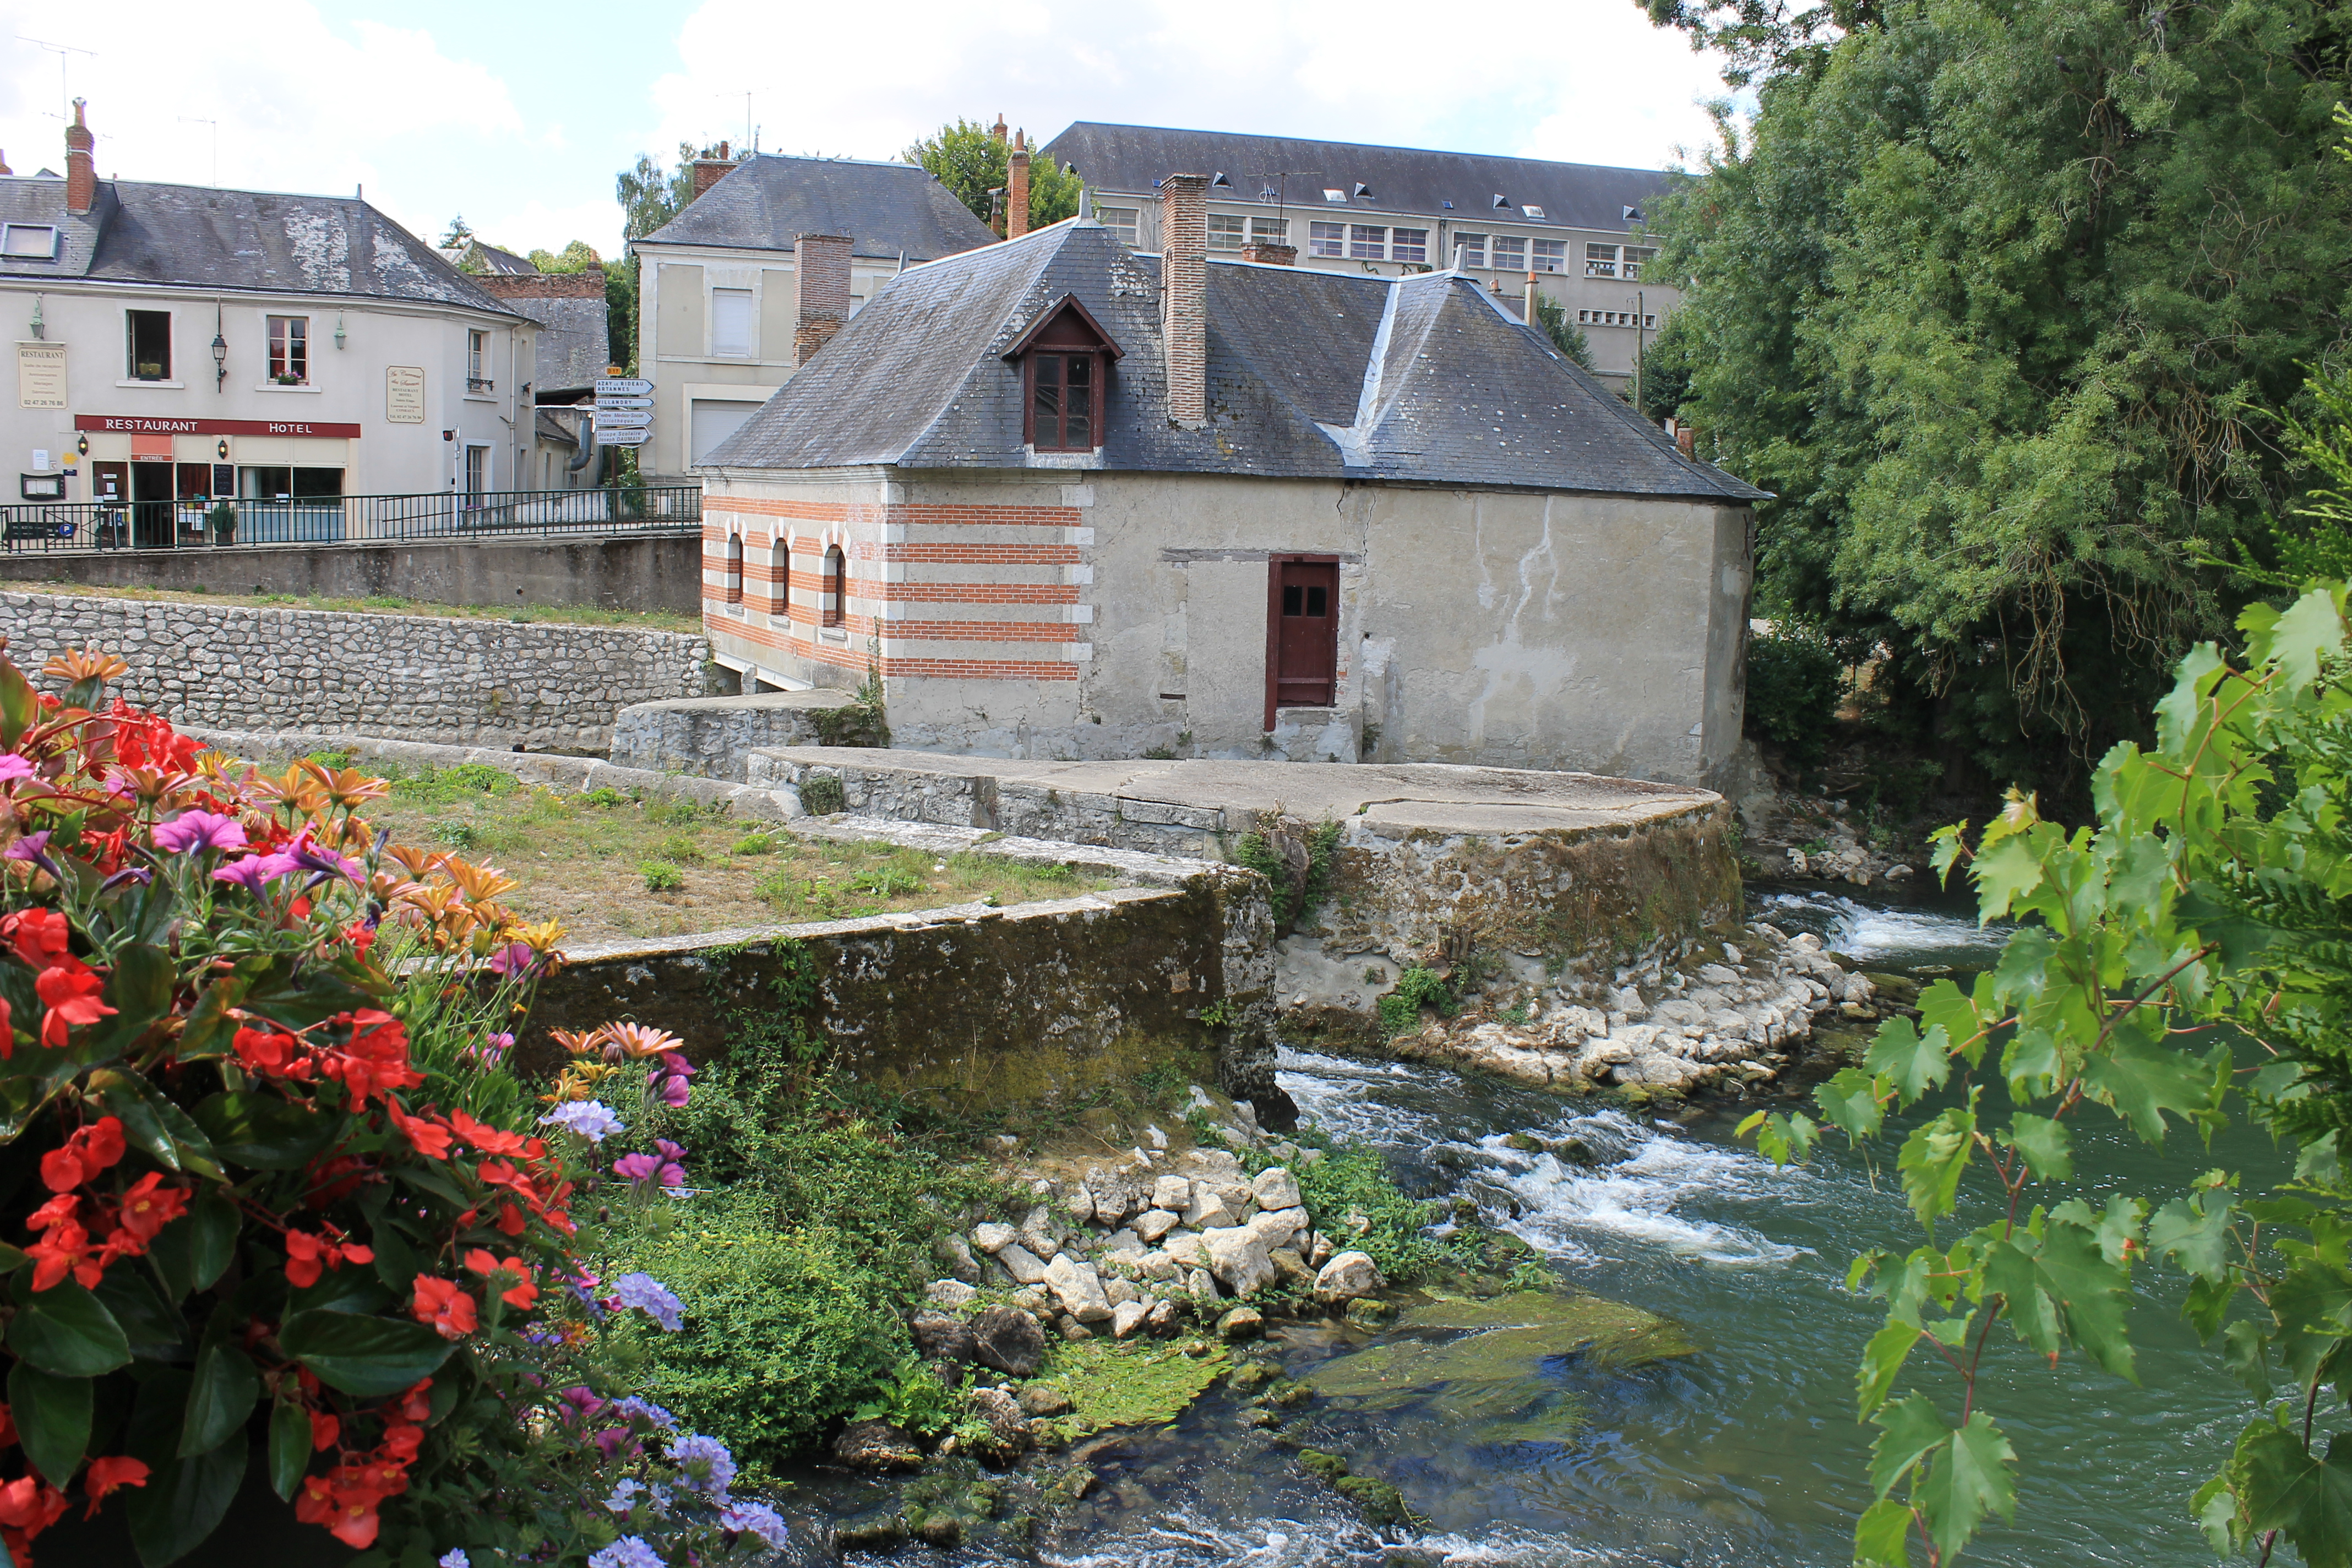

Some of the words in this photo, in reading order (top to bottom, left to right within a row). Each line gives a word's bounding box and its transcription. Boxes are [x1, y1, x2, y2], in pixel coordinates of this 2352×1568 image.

[21, 351, 64, 359] RESTAURANT
[105, 418, 198, 432] RESTAURANT
[269, 423, 312, 433] HOTEL
